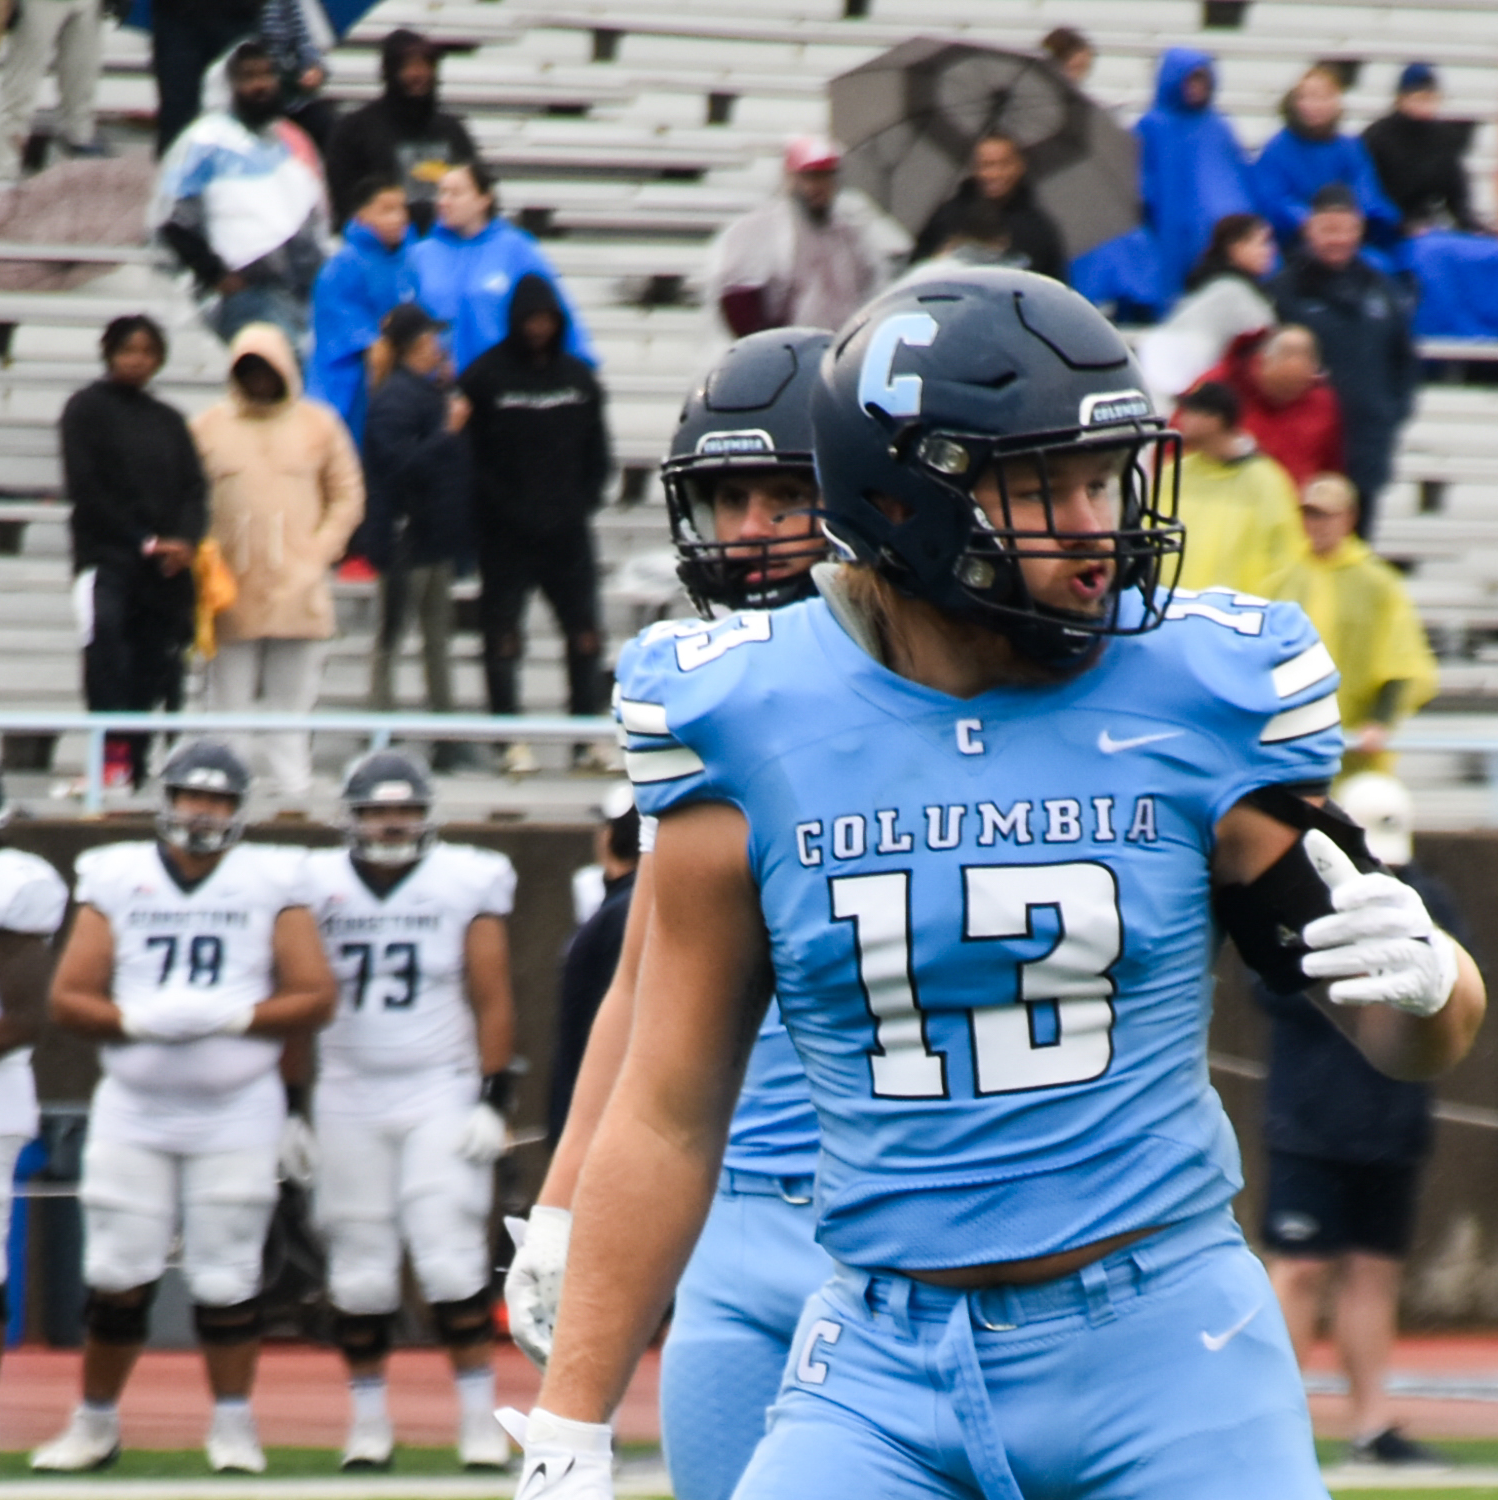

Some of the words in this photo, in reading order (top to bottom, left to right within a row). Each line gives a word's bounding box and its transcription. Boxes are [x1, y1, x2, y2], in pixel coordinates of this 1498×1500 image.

[858, 313, 939, 417] C
[955, 718, 985, 756] C
[795, 796, 1159, 867] COLUMBIA
[145, 935, 225, 988] 78
[339, 942, 421, 1011] 73
[827, 859, 1125, 1100] 13
[795, 1316, 844, 1387] C
